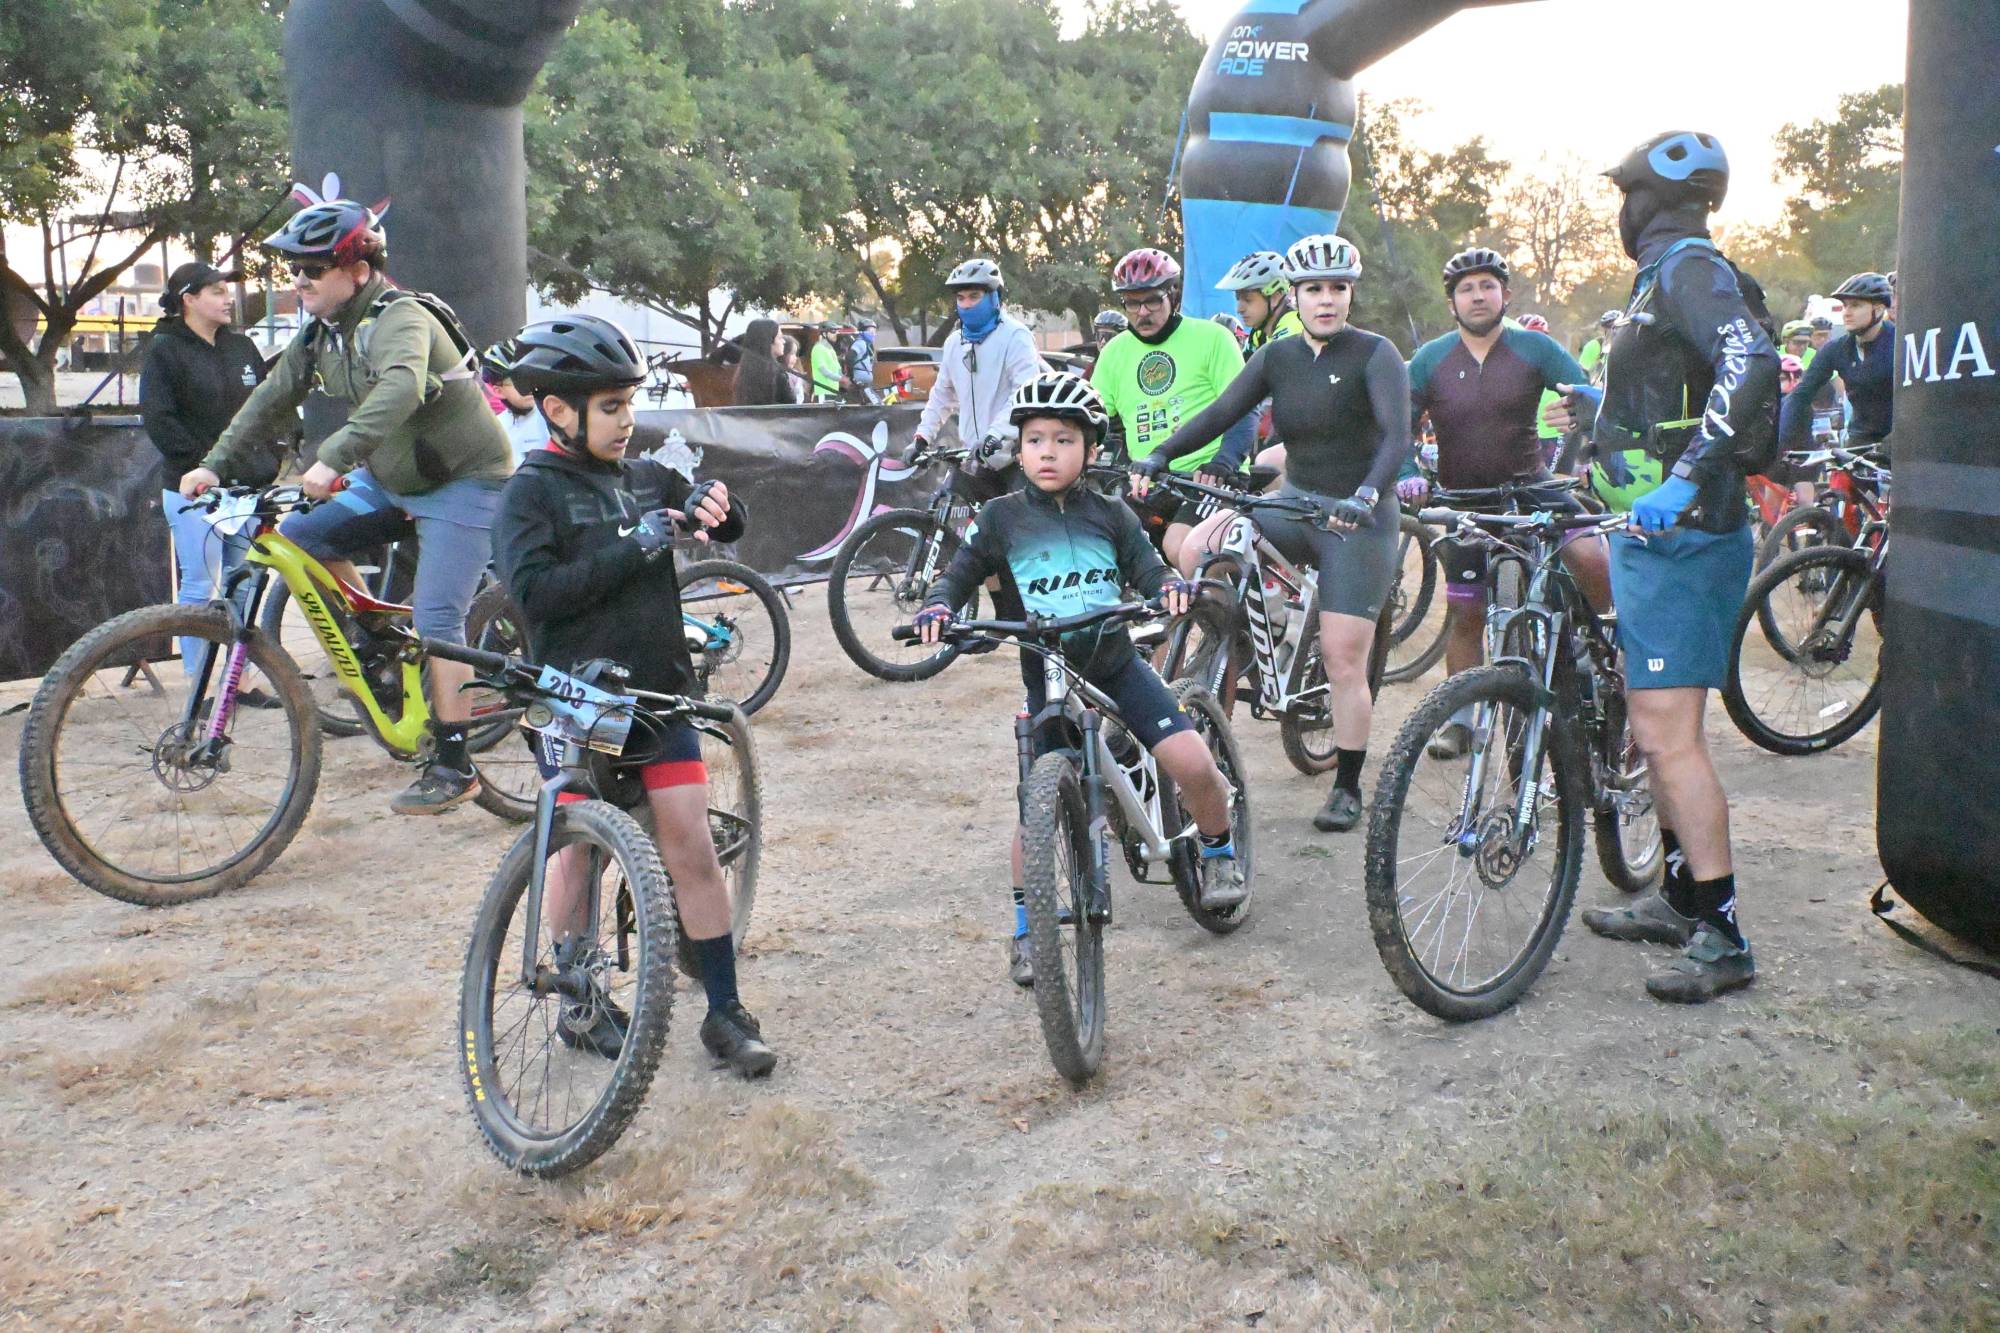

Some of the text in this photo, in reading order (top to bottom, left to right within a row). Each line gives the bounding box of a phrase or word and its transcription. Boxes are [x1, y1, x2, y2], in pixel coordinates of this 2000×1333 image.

[1222, 41, 1309, 62] POWER
[1216, 58, 1265, 76] ADE
[1735, 318, 1754, 344] MTB
[1903, 321, 1996, 387] MA
[921, 540, 941, 585] SID
[1027, 568, 1119, 596] RIDER
[465, 1030, 486, 1102] MAXXIS
